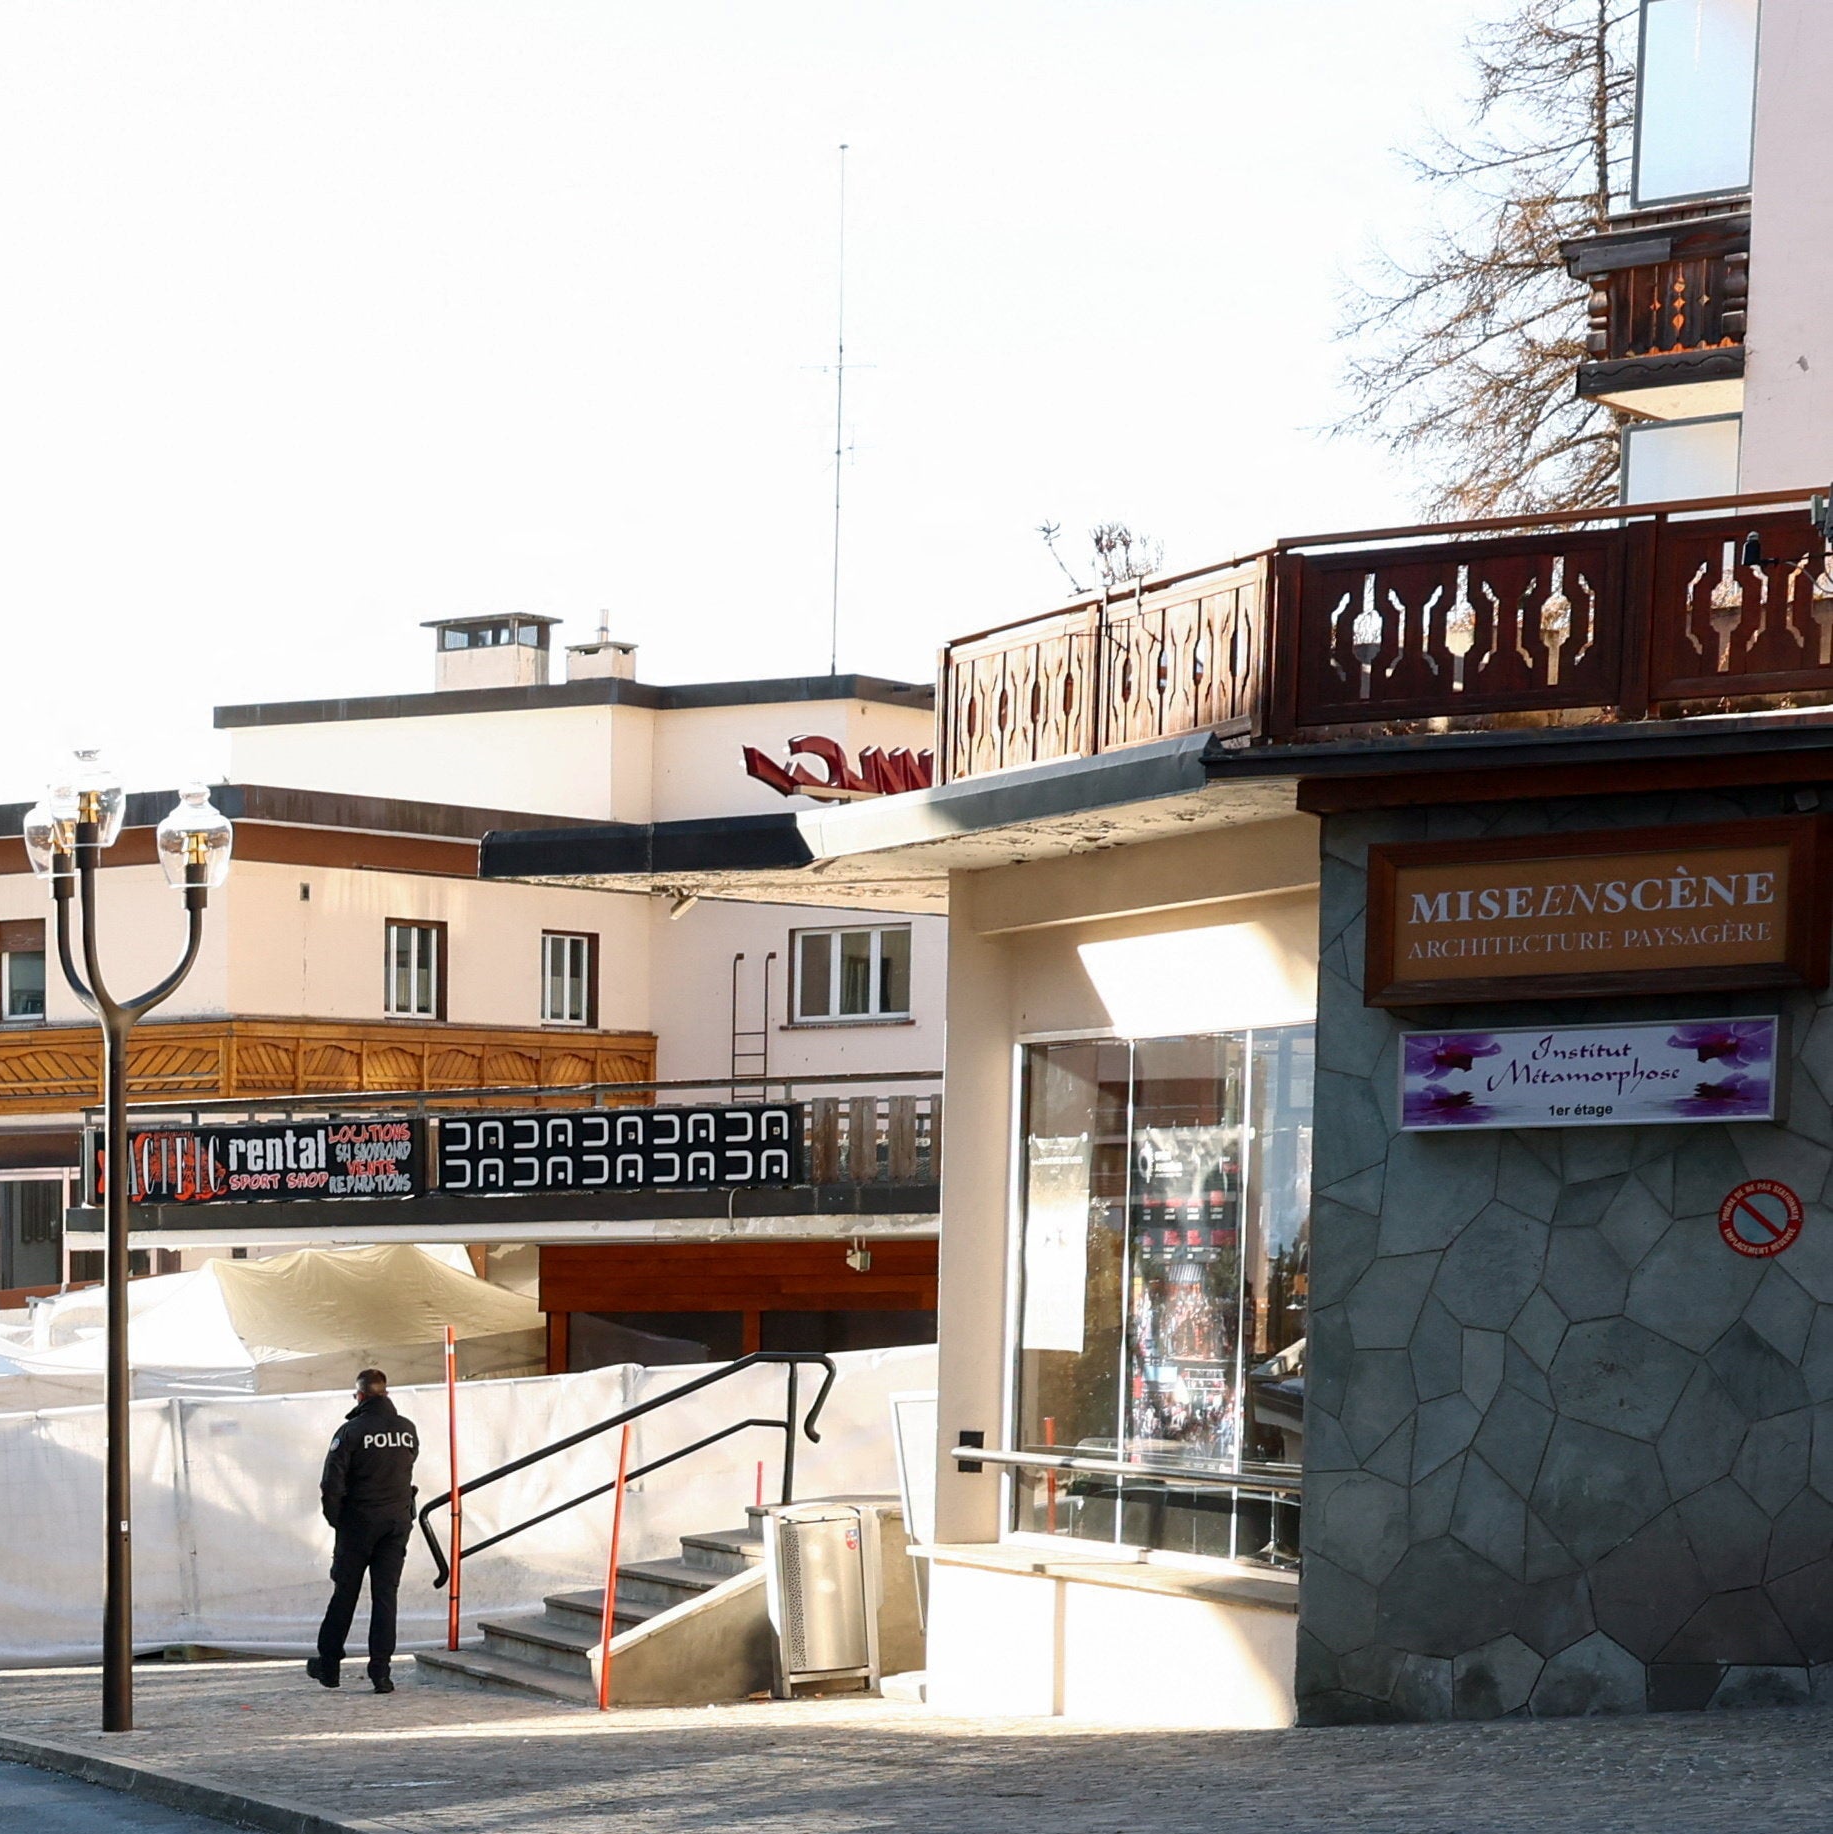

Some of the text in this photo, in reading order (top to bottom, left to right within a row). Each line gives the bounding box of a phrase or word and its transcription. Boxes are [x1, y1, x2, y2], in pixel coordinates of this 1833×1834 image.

[1407, 918, 1773, 960] ARCHITECTURE PAYSAGÈRE
[1531, 1034, 1633, 1061] Institut
[1486, 1057, 1681, 1096] Métamorphose
[1548, 1103, 1614, 1119] 1er étage
[328, 1122, 411, 1144] LOCATIONS
[126, 1129, 326, 1196] ACIFIC rental
[346, 1159, 400, 1176] VENTE
[228, 1171, 330, 1191] SPORT SHOP
[328, 1173, 412, 1194] REPARATIONS
[363, 1431, 414, 1449] POLIC
